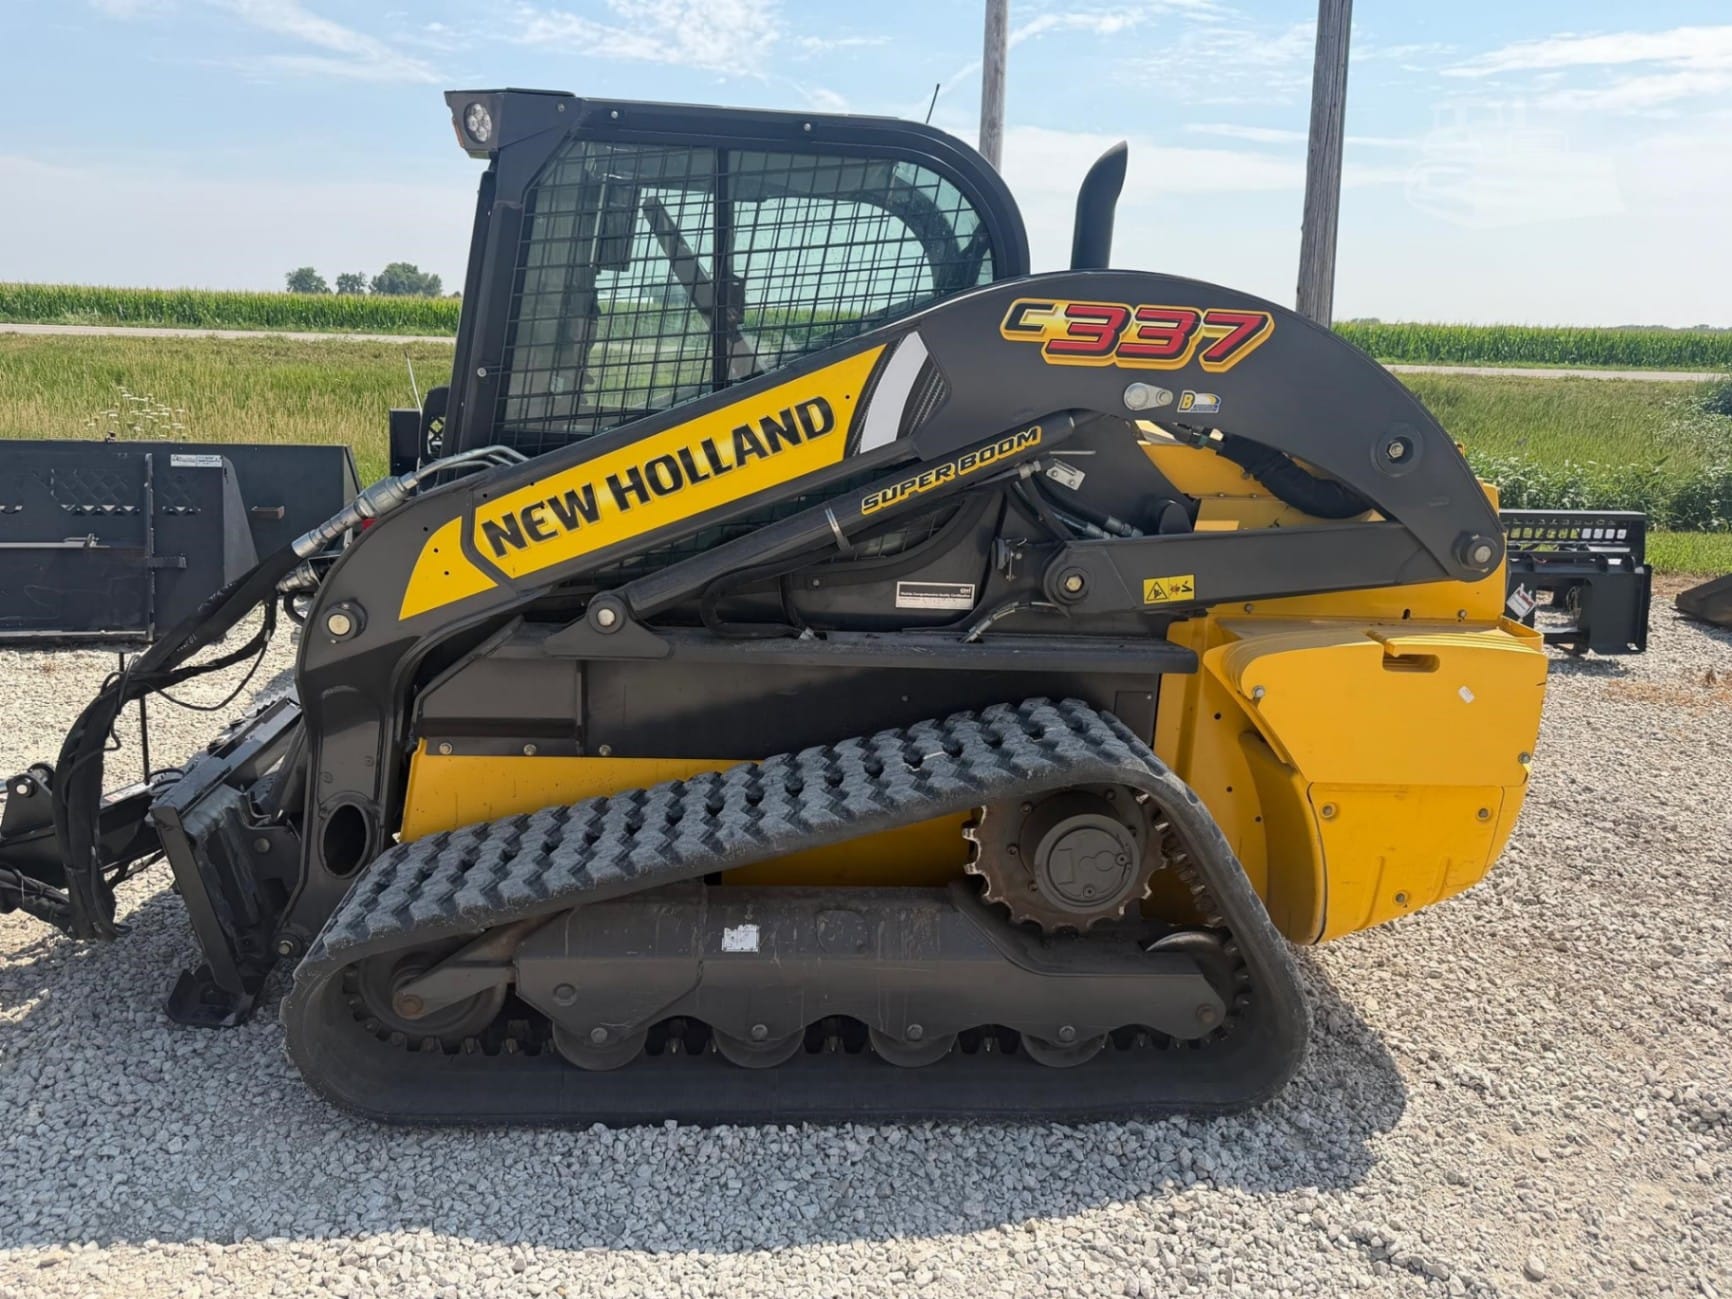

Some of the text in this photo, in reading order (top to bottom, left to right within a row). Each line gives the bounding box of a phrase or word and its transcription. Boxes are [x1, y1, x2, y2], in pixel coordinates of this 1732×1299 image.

[1002, 299, 1273, 370] C337
[480, 396, 836, 559] NEW HOLLAND
[862, 426, 1042, 514] SUPER BOOM
